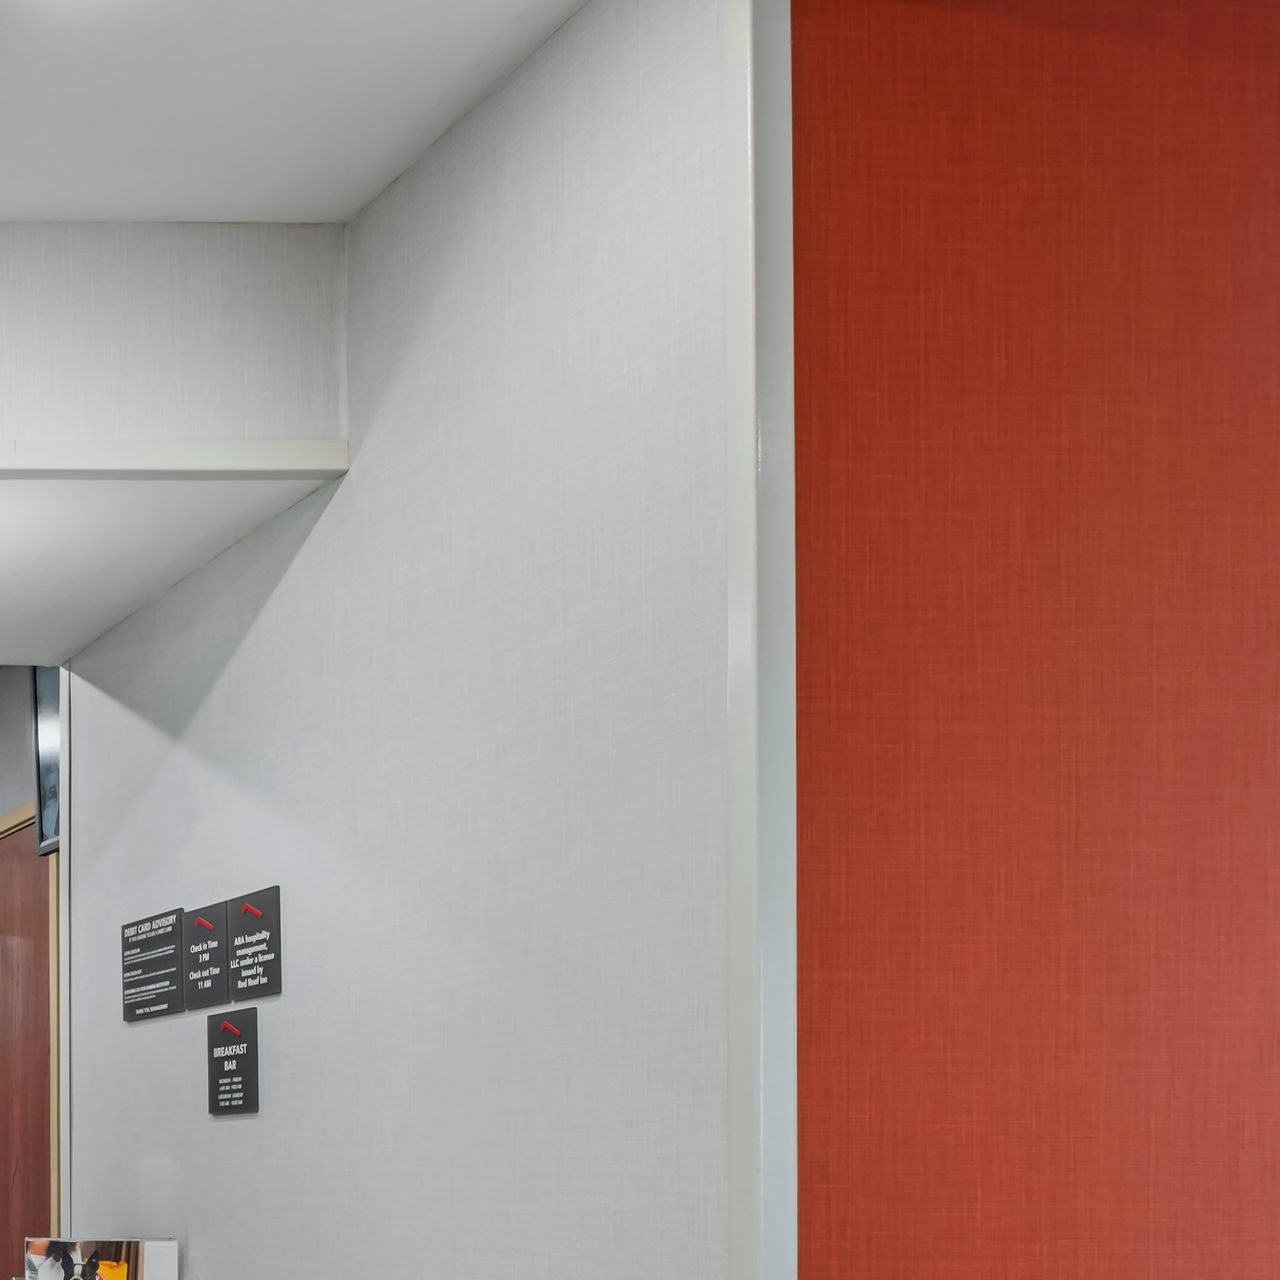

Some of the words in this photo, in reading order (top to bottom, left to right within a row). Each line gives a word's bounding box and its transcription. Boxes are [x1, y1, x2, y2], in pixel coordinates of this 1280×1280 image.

[137, 921, 151, 934] CARD
[151, 914, 177, 930] ADVISORY
[244, 930, 271, 944] hospitality
[190, 943, 202, 954] Check
[202, 942, 208, 951] in
[207, 940, 218, 950] Time
[202, 952, 210, 962] PM
[230, 959, 240, 969] LLC
[239, 956, 254, 967] under
[258, 953, 275, 963] license
[189, 970, 201, 980] Check
[201, 969, 210, 978] out
[209, 967, 220, 976] Time
[241, 965, 256, 977] issued
[256, 965, 264, 976] by
[197, 981, 204, 990] 11
[203, 979, 212, 989] AM
[237, 979, 248, 989] Red
[247, 975, 260, 987] Roof
[213, 1043, 248, 1058] BREAKFAST
[224, 1059, 237, 1071] BAR
